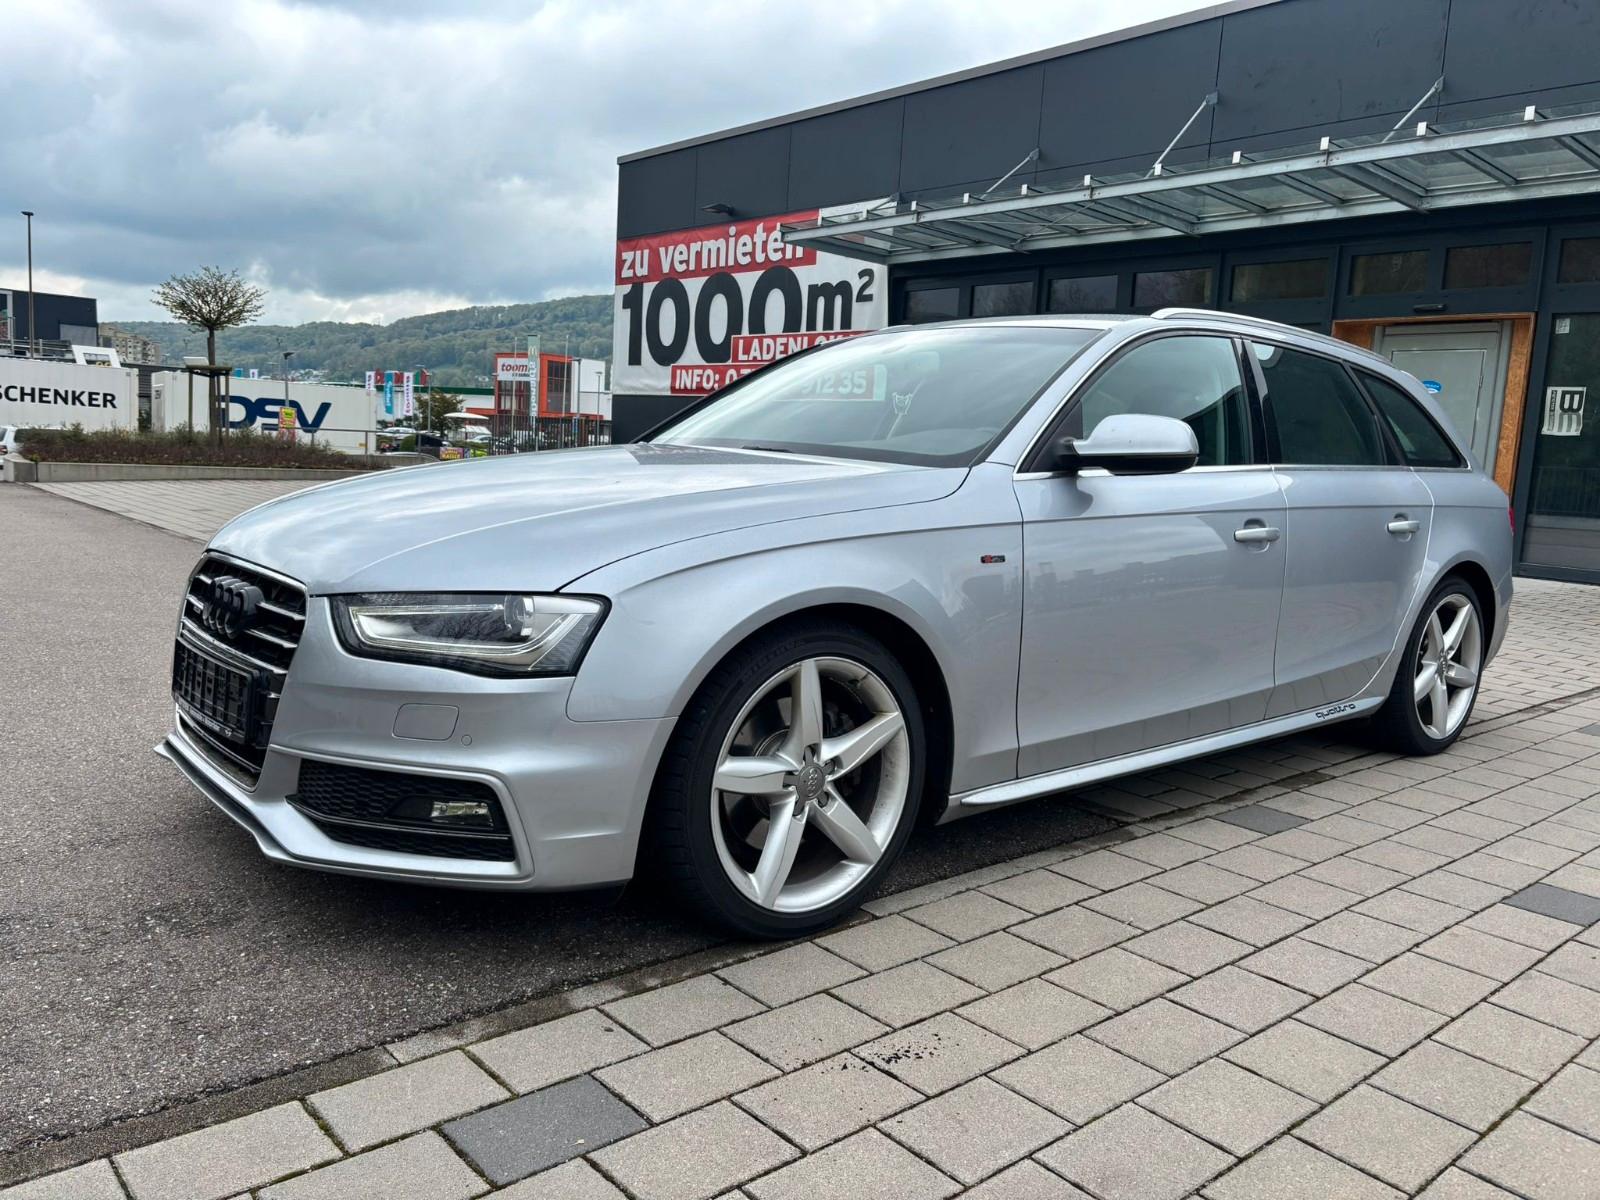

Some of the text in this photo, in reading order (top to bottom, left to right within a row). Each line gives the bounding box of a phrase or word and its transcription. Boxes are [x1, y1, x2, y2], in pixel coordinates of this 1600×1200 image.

[621, 248, 649, 278] zu
[501, 362, 528, 373] toom
[675, 368, 720, 391] INFO:
[0, 385, 117, 409] CHENKER
[219, 395, 332, 433] DSV
[1315, 703, 1356, 719] quattro
